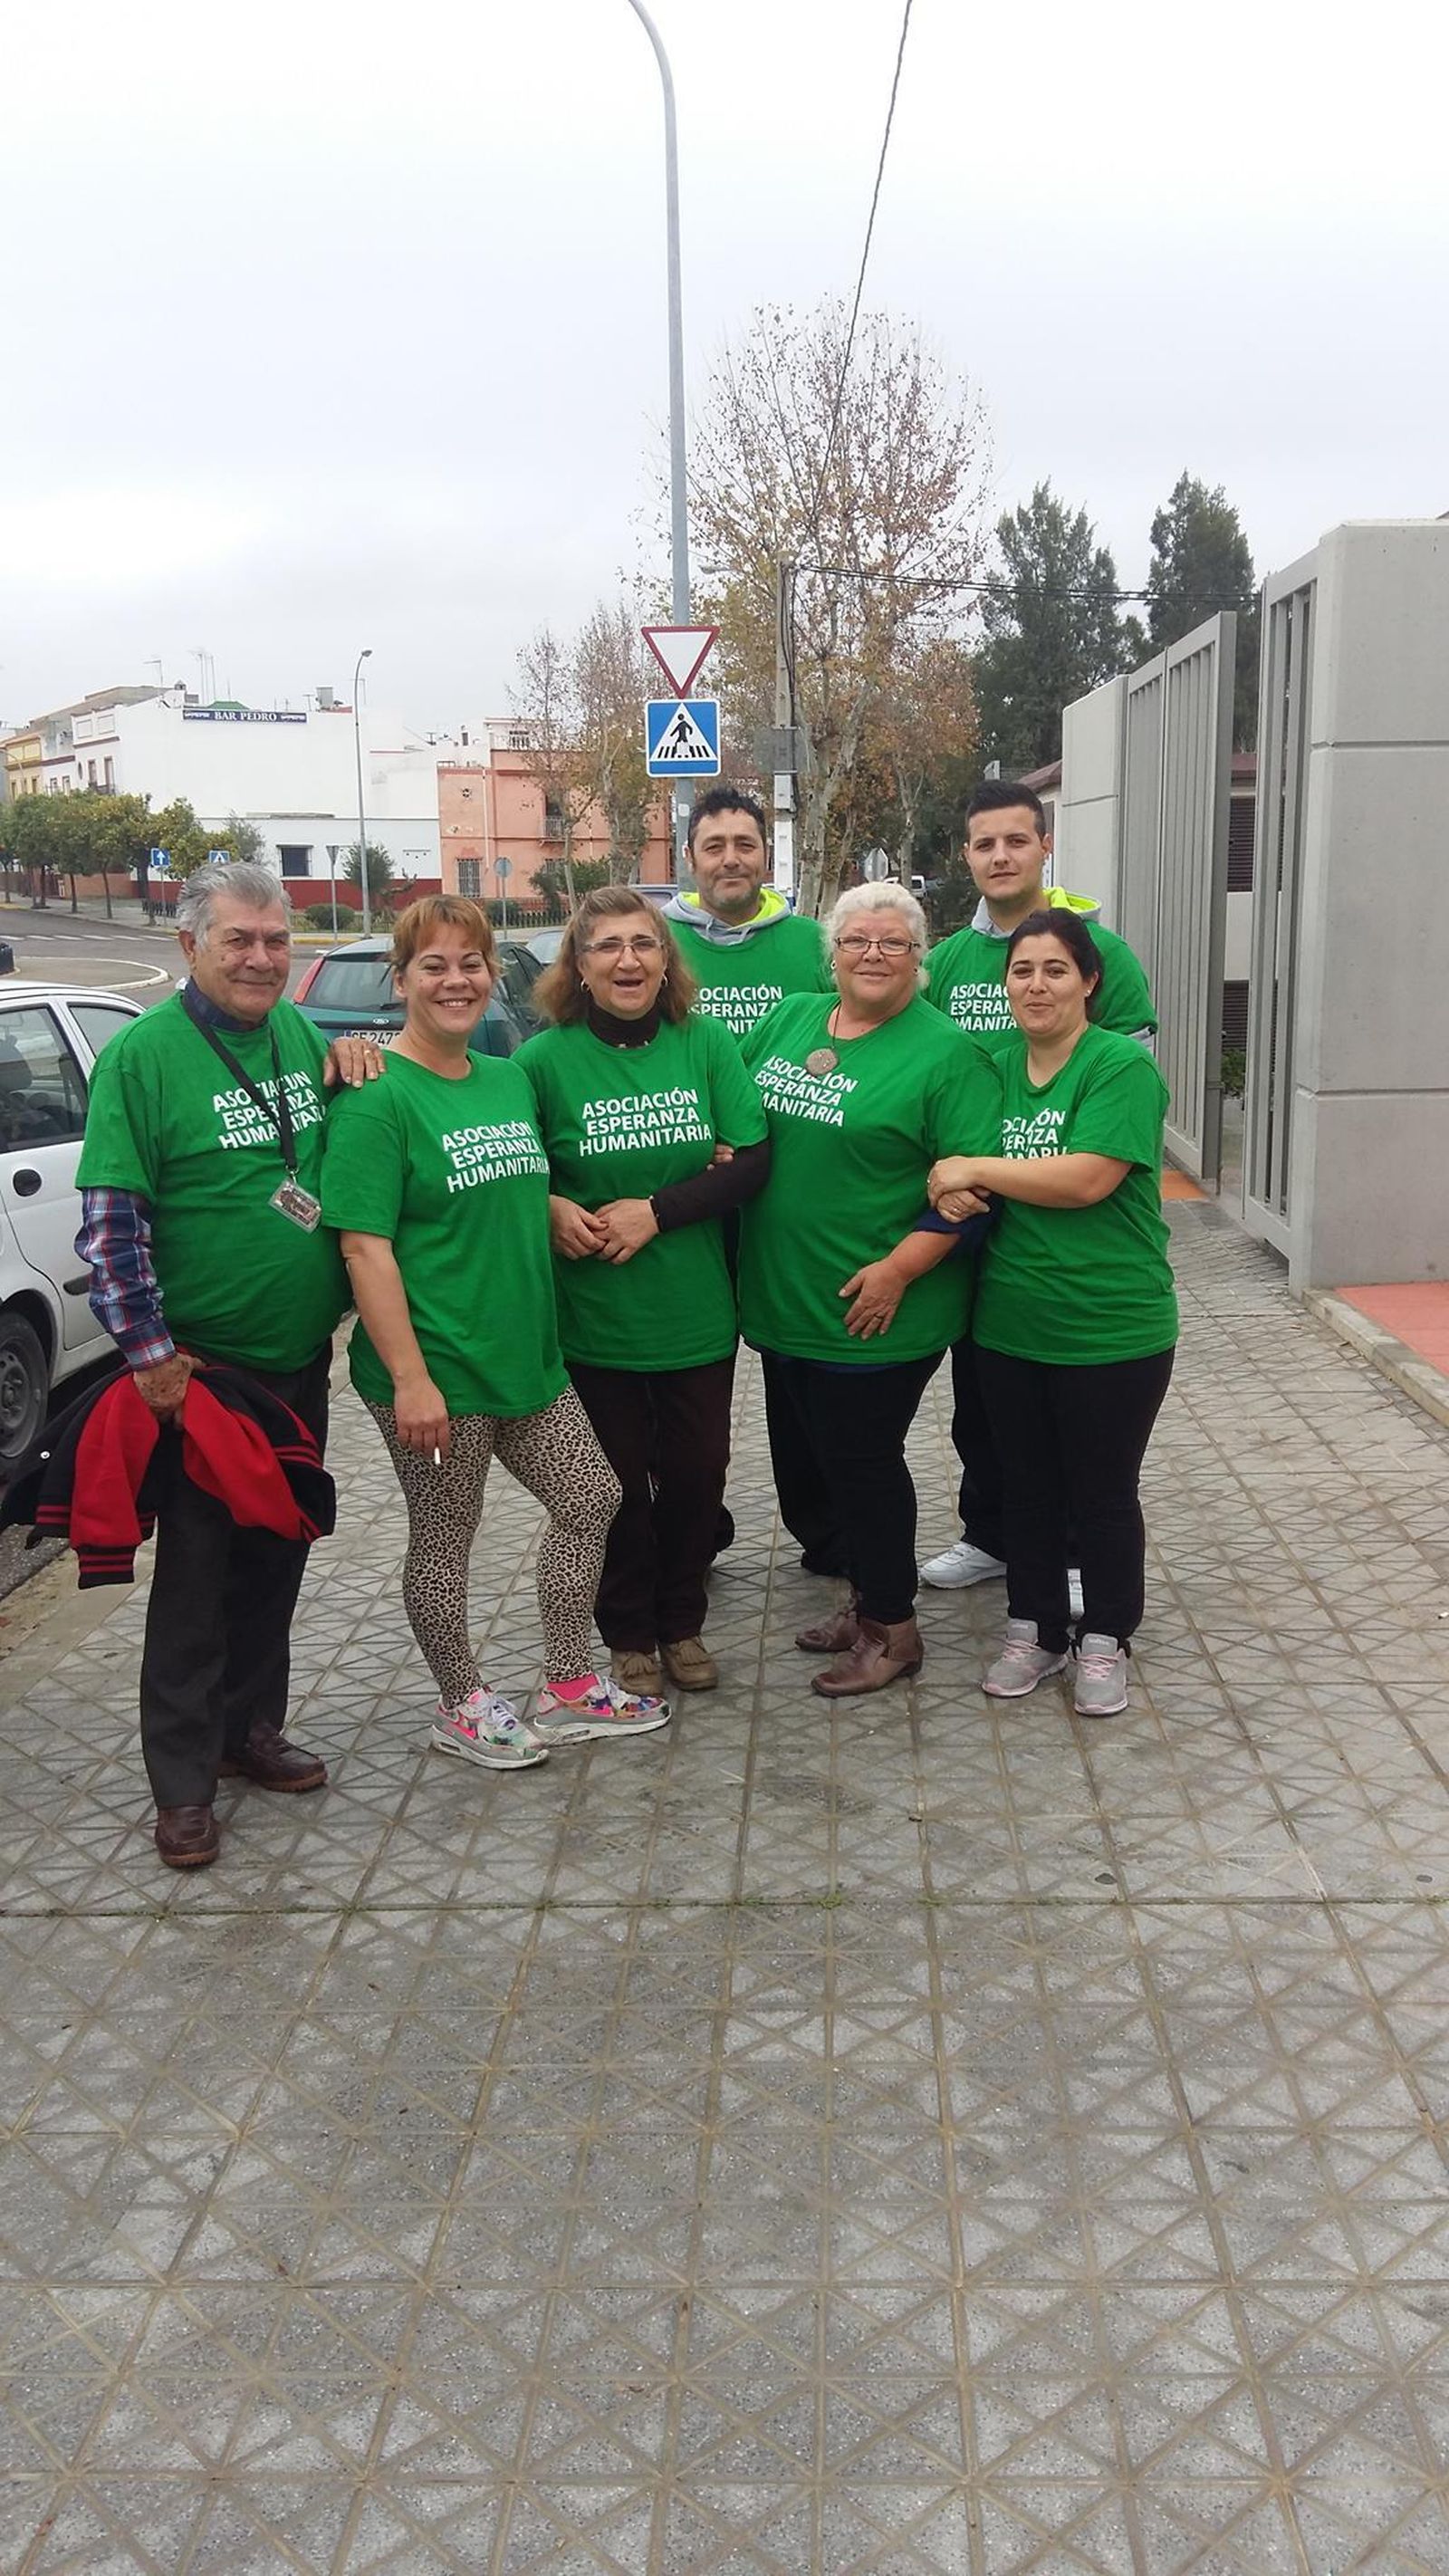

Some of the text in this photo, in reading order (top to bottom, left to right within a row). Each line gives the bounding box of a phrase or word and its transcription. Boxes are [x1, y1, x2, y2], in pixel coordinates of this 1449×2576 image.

[215, 711, 236, 721] BAR
[240, 712, 277, 722] PEDRO
[695, 984, 782, 1001] OCIACIÓN
[688, 1003, 779, 1017] SPERANZ
[754, 1071, 842, 1106] ESPERANZA
[763, 1055, 859, 1092] ASOCIAIÓN
[582, 1087, 698, 1120] ASOCIACIÓN
[442, 1120, 534, 1151] ASOCIACIÓN
[586, 1107, 700, 1136] ESPERANZA
[451, 1138, 542, 1169] ESPERANZA
[580, 1124, 712, 1157] HUMANITARIA
[446, 1156, 550, 1193] HUMANITARIA
